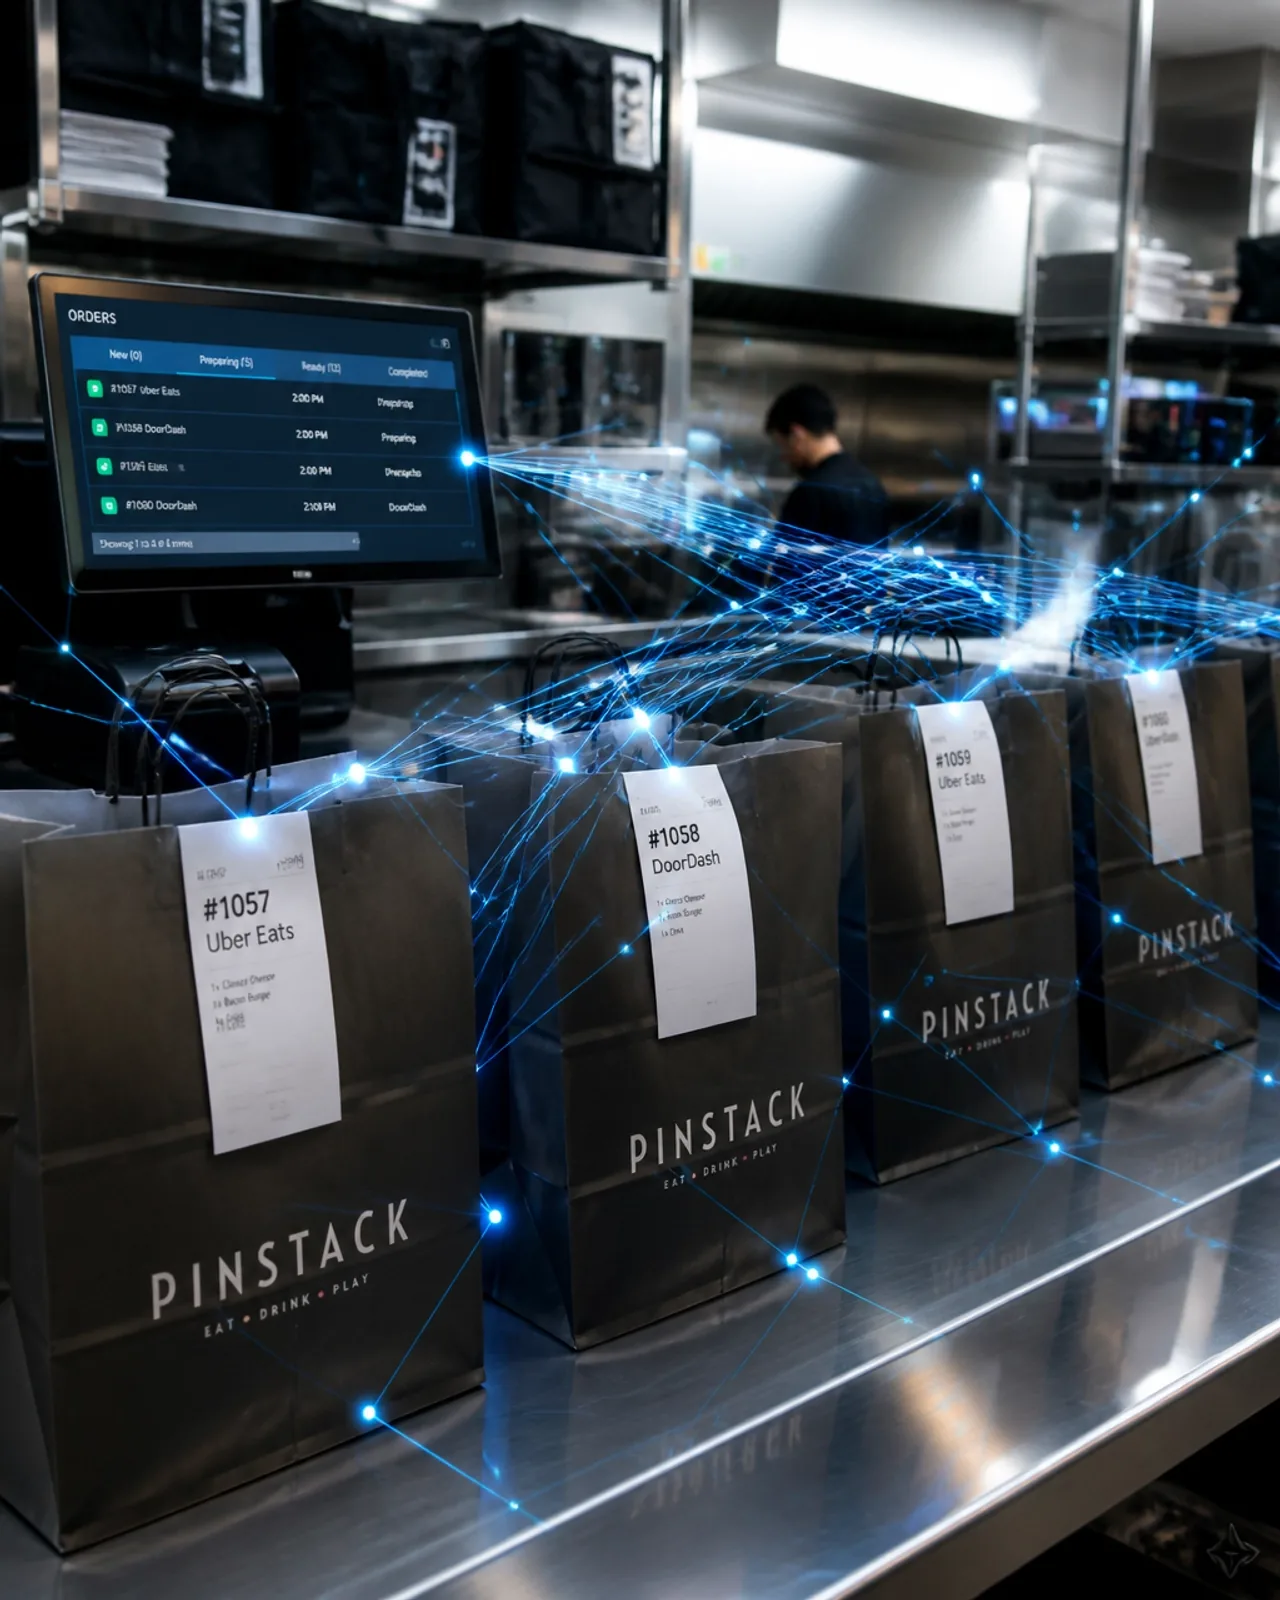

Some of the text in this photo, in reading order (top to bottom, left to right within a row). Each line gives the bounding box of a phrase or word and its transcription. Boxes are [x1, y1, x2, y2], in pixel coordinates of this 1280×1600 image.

[67, 308, 117, 325] ORDERS
[109, 348, 128, 361] New
[199, 354, 239, 369] Preparing
[161, 385, 181, 397] Eats
[311, 393, 325, 404] PM
[314, 430, 328, 441] PM
[318, 466, 332, 476] PM
[935, 749, 972, 768] #1059
[938, 772, 987, 790] Uber Eats
[648, 823, 701, 849] #1058
[652, 849, 721, 875] DoorDash
[203, 889, 271, 922] #1057
[206, 922, 295, 954] Uber Eats
[1138, 911, 1235, 964] PINSTACK
[922, 977, 1050, 1044] PINSTACK
[629, 1082, 806, 1174] PINSTACK
[663, 1143, 778, 1190] EAT DRINK PLAY
[151, 1198, 409, 1321] PINSTACK
[203, 1273, 370, 1339] EAT DRINK PLAY
